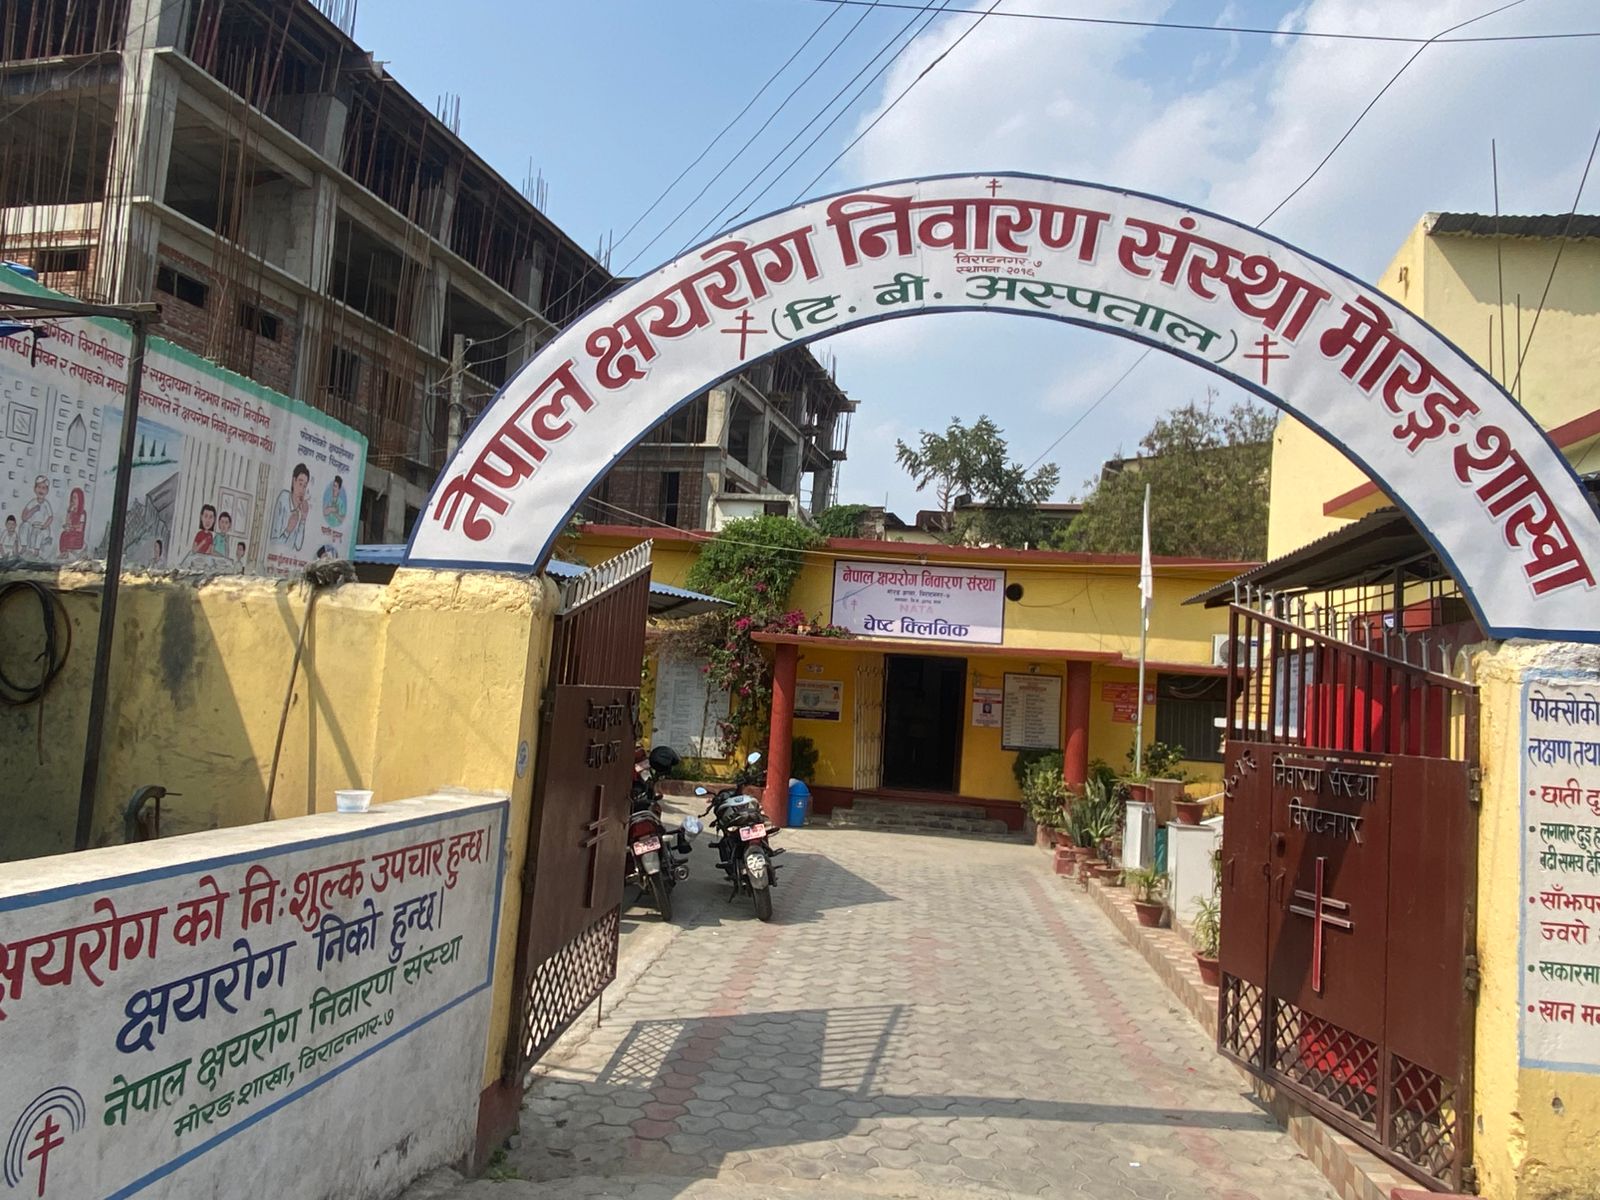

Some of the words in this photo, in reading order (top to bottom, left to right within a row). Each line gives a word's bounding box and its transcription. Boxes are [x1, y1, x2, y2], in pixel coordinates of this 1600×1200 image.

[433, 359, 593, 542] नेपाल
[586, 226, 819, 390] क्षयरोग
[826, 195, 1110, 267] निवारण
[1118, 216, 1331, 342] संस्था
[1453, 425, 1597, 595] शाखा
[843, 566, 873, 585] नेपाल
[877, 569, 917, 588] क्षयरोग
[921, 569, 963, 589] निवारण
[966, 574, 996, 592] संस्था
[864, 614, 894, 634] चेष्ट
[1528, 738, 1572, 767] लक्षण
[1272, 756, 1324, 794] निवारण
[173, 875, 229, 947] को
[371, 838, 445, 893] उपचार
[1540, 919, 1590, 945] ज्वरो
[115, 938, 297, 1054] क्षयरोग
[312, 898, 384, 972] निको
[1539, 1000, 1576, 1024] खान
[104, 1058, 192, 1127] नेपाल
[197, 1008, 302, 1092] क्षयरोग
[309, 965, 397, 1033] निवारण
[403, 934, 463, 985] संस्था
